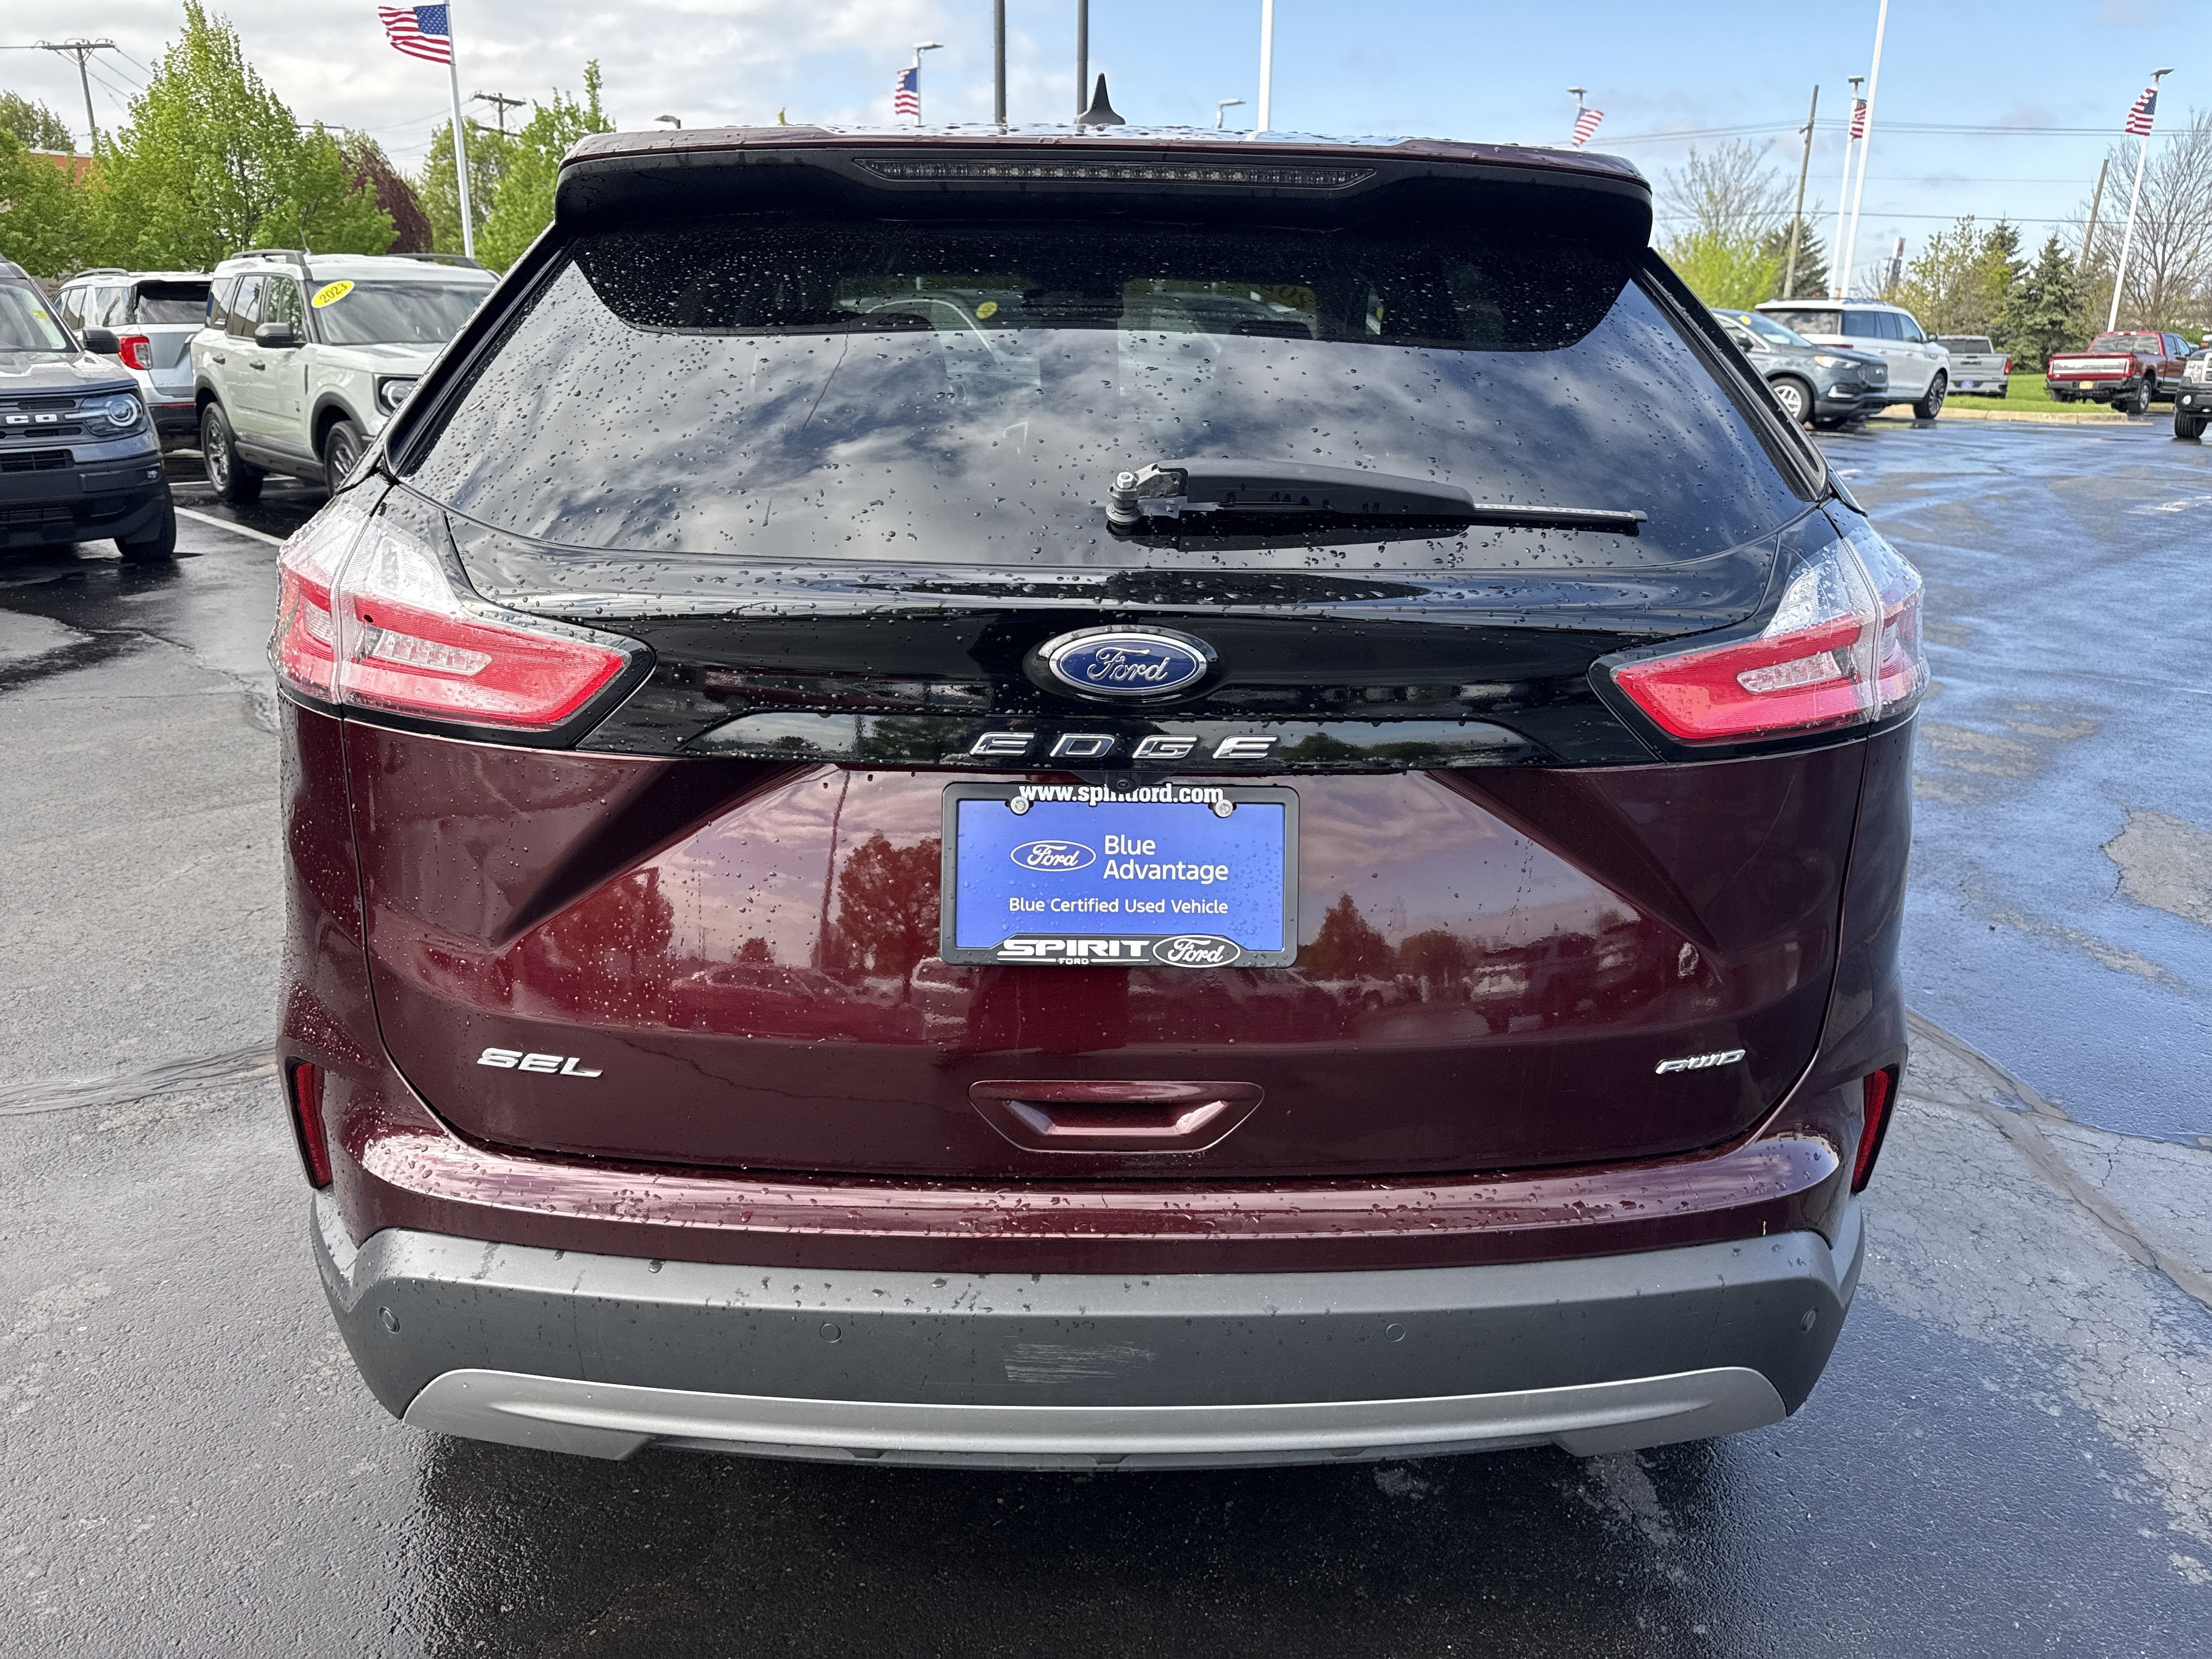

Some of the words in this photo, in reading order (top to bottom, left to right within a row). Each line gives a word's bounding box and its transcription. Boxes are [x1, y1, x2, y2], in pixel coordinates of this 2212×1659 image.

[319, 283, 347, 303] 2023
[1086, 646, 1170, 682] Ford
[969, 732, 1278, 759] EDGE
[1026, 844, 1080, 867] Ford
[1104, 834, 1156, 855] Blue
[1103, 859, 1229, 884] Advantage
[1009, 896, 1045, 911] Blue
[1051, 898, 1119, 912] Certified
[1125, 899, 1165, 913] Used
[1171, 899, 1228, 913] Vehicle
[997, 939, 1150, 957] SPIRIT
[1167, 938, 1225, 963] Ford
[477, 1047, 603, 1078] SEL
